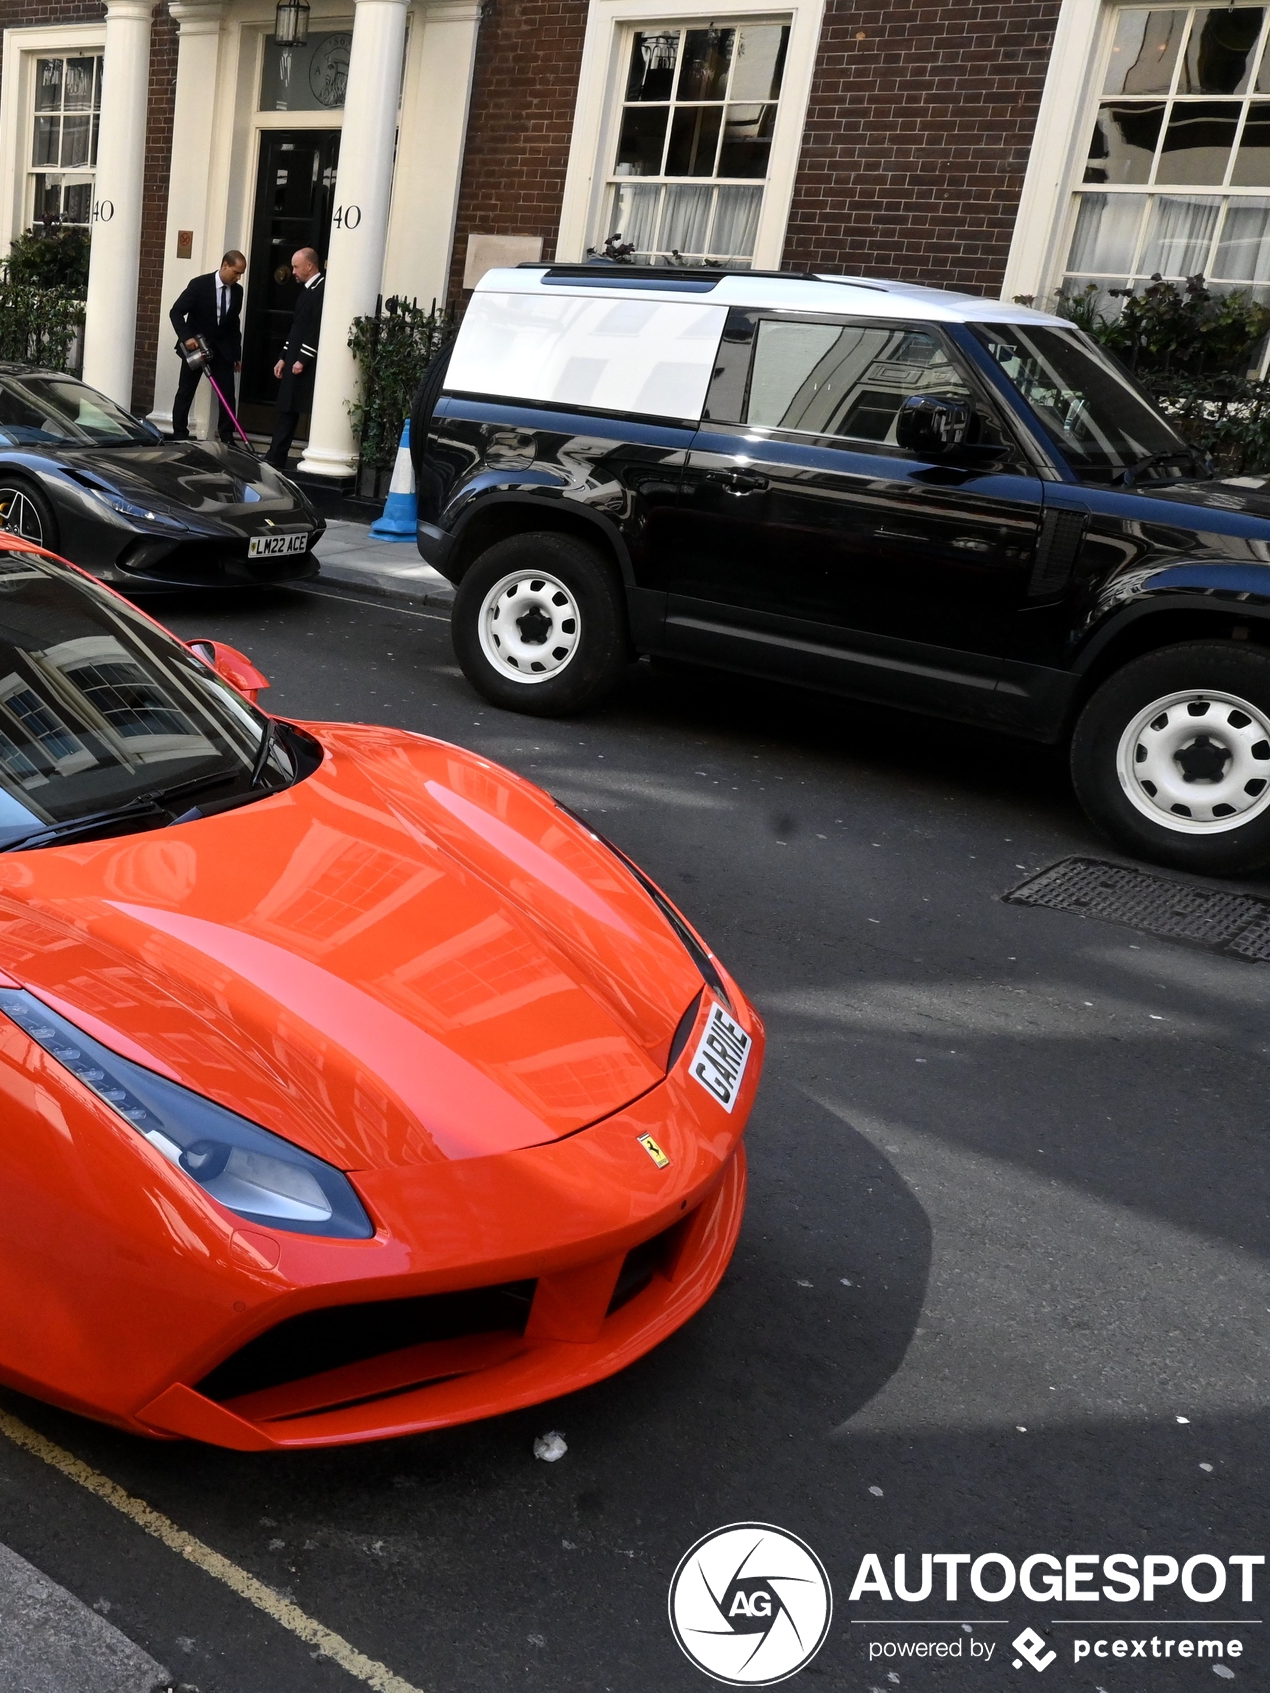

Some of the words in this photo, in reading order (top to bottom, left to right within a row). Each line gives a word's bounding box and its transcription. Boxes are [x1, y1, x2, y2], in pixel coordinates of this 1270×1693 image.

[93, 200, 115, 222] 40
[333, 205, 362, 230] 40
[256, 537, 286, 555] LM22
[286, 535, 307, 552] ACE
